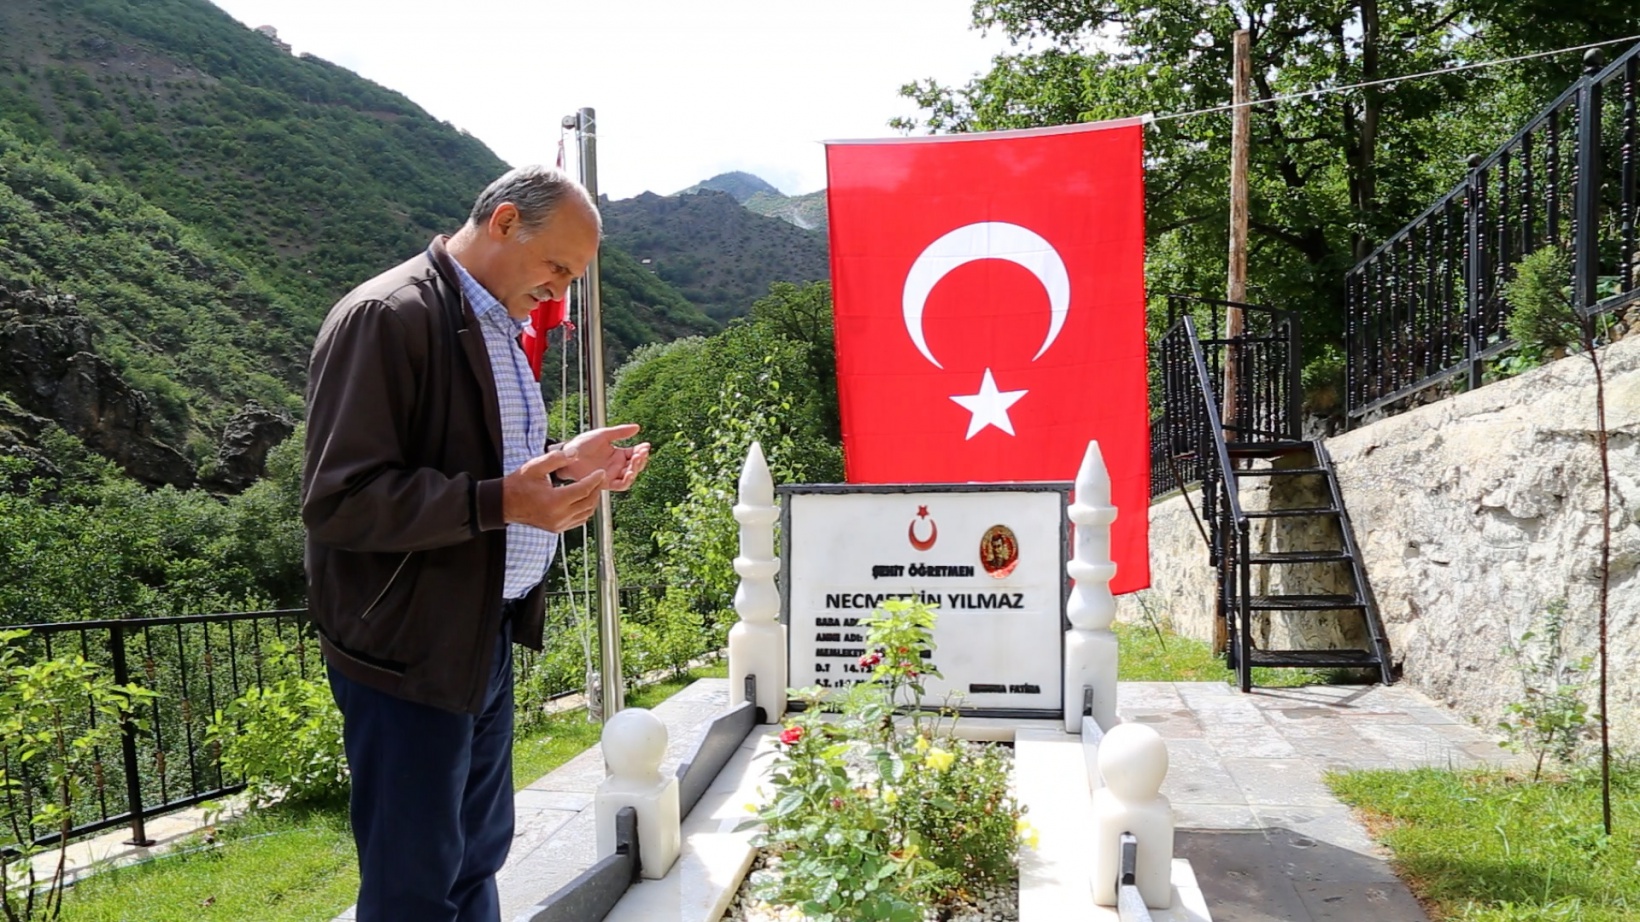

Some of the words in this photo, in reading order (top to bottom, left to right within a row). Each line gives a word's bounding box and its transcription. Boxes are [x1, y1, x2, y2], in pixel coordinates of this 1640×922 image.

[872, 564, 905, 580] ŞEHİT
[908, 562, 975, 578] ÖĞRETMEN
[826, 590, 942, 609] NECMİN
[947, 593, 1024, 609] YILMAZ
